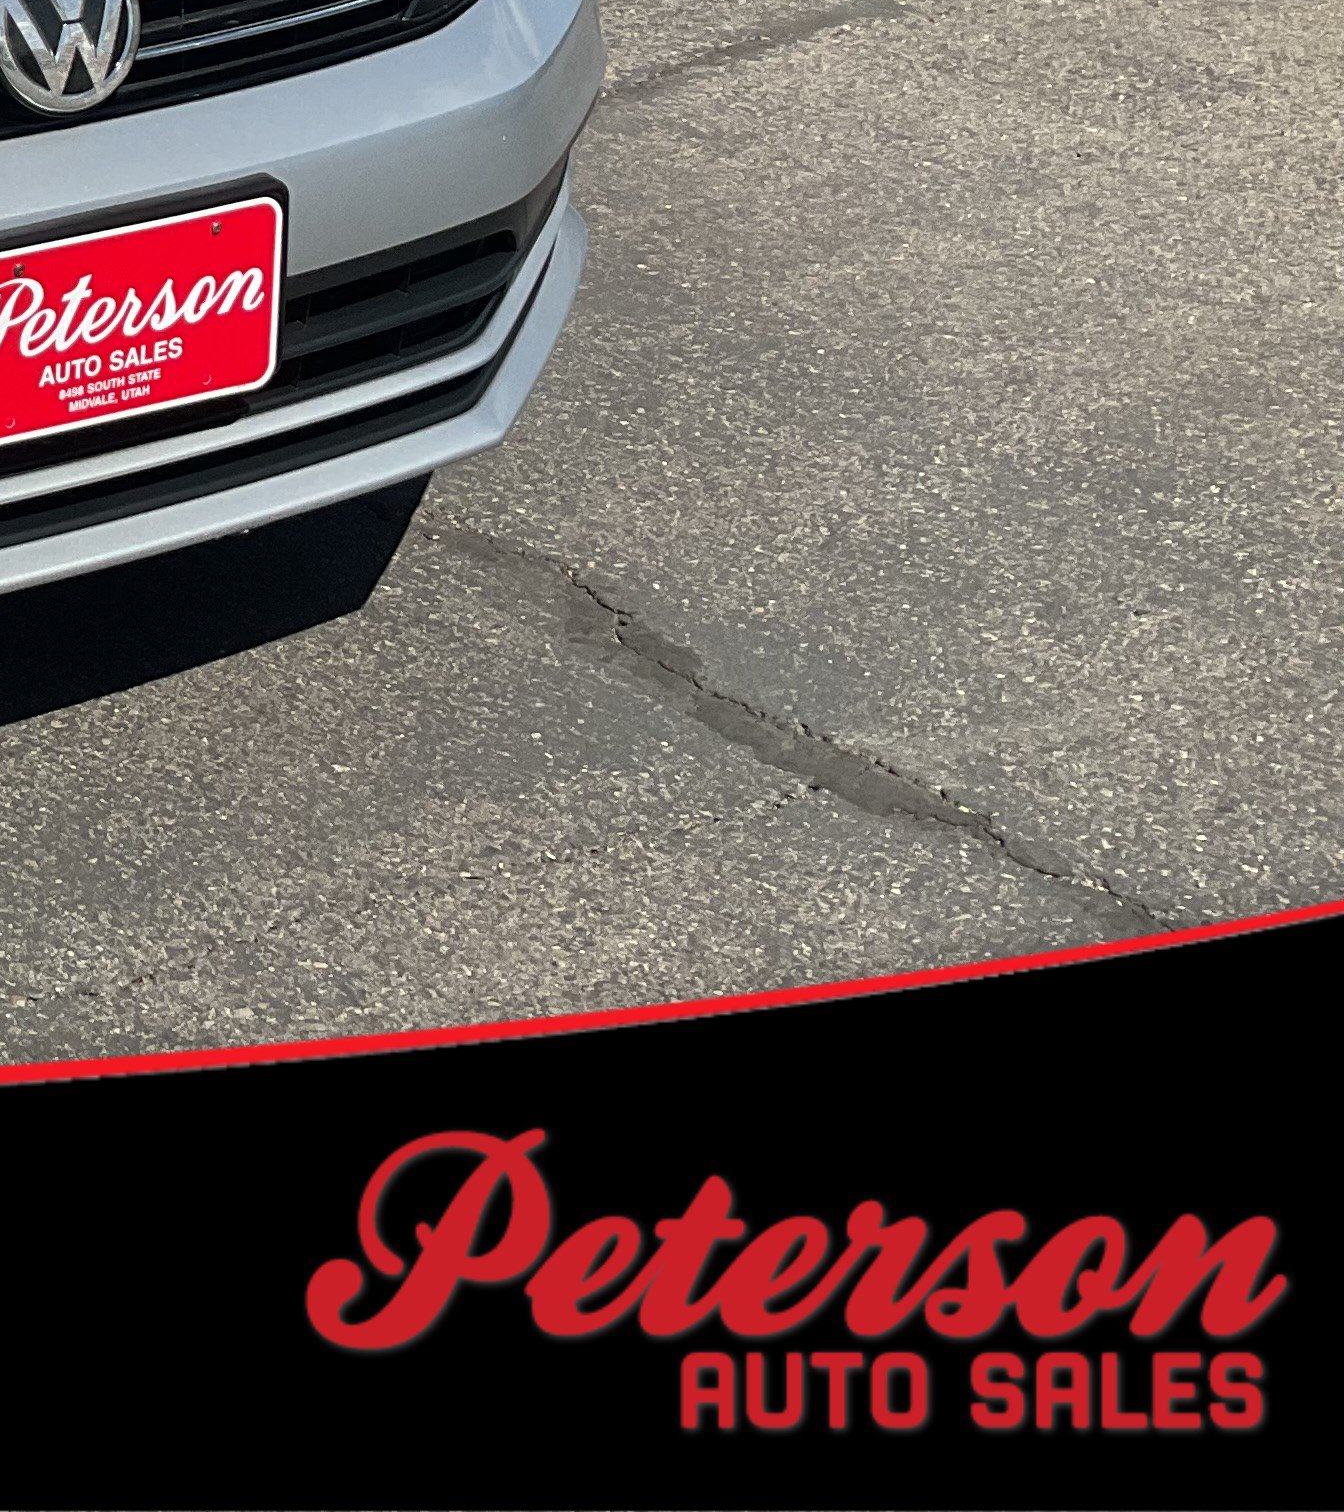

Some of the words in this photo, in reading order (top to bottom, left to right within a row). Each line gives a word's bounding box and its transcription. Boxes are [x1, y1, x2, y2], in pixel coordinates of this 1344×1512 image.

[39, 355, 102, 387] AUTO
[108, 337, 184, 372] SALES
[87, 376, 125, 395] SOUTH
[128, 368, 161, 386] STATE
[121, 385, 151, 402] UTAH
